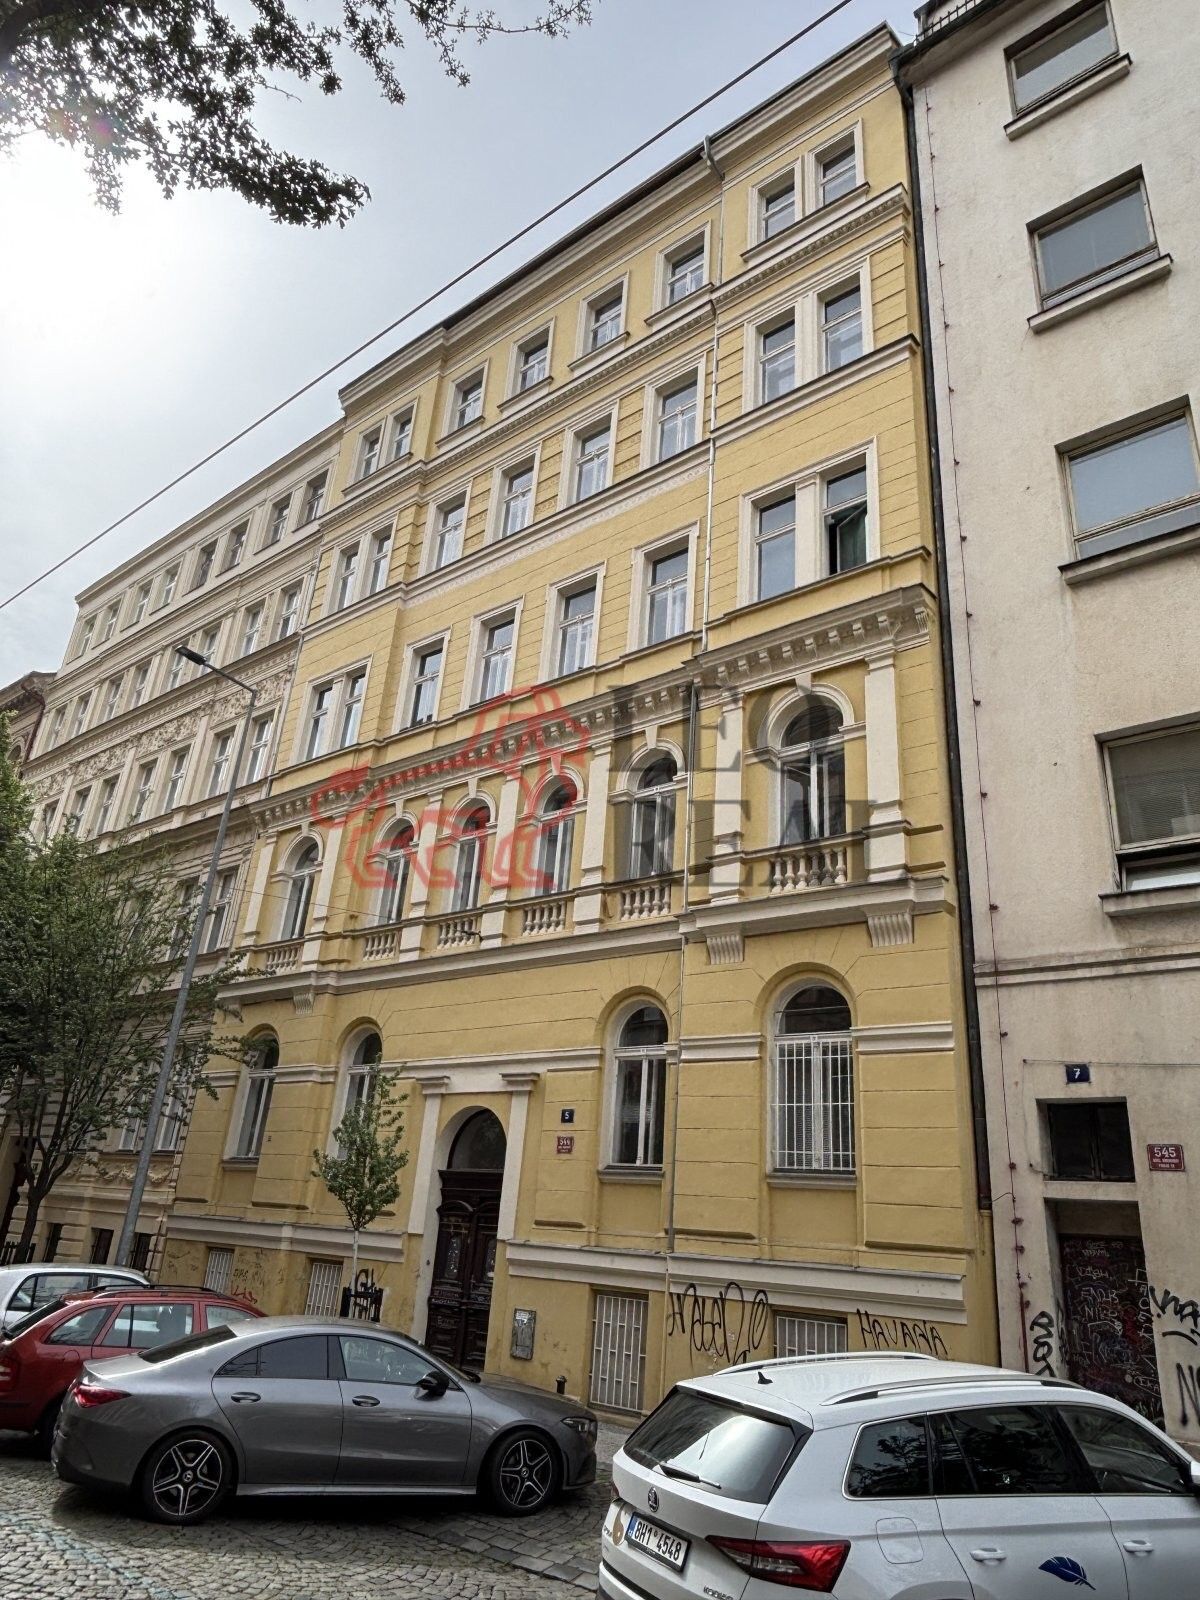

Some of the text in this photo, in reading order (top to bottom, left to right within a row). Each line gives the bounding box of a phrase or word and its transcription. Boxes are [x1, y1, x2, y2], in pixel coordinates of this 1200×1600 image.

[1073, 1068, 1081, 1079] 7
[564, 1111, 570, 1120] 5
[1154, 1147, 1176, 1158] 545
[634, 1520, 652, 1548] 8H1
[656, 1533, 682, 1562] 4548
